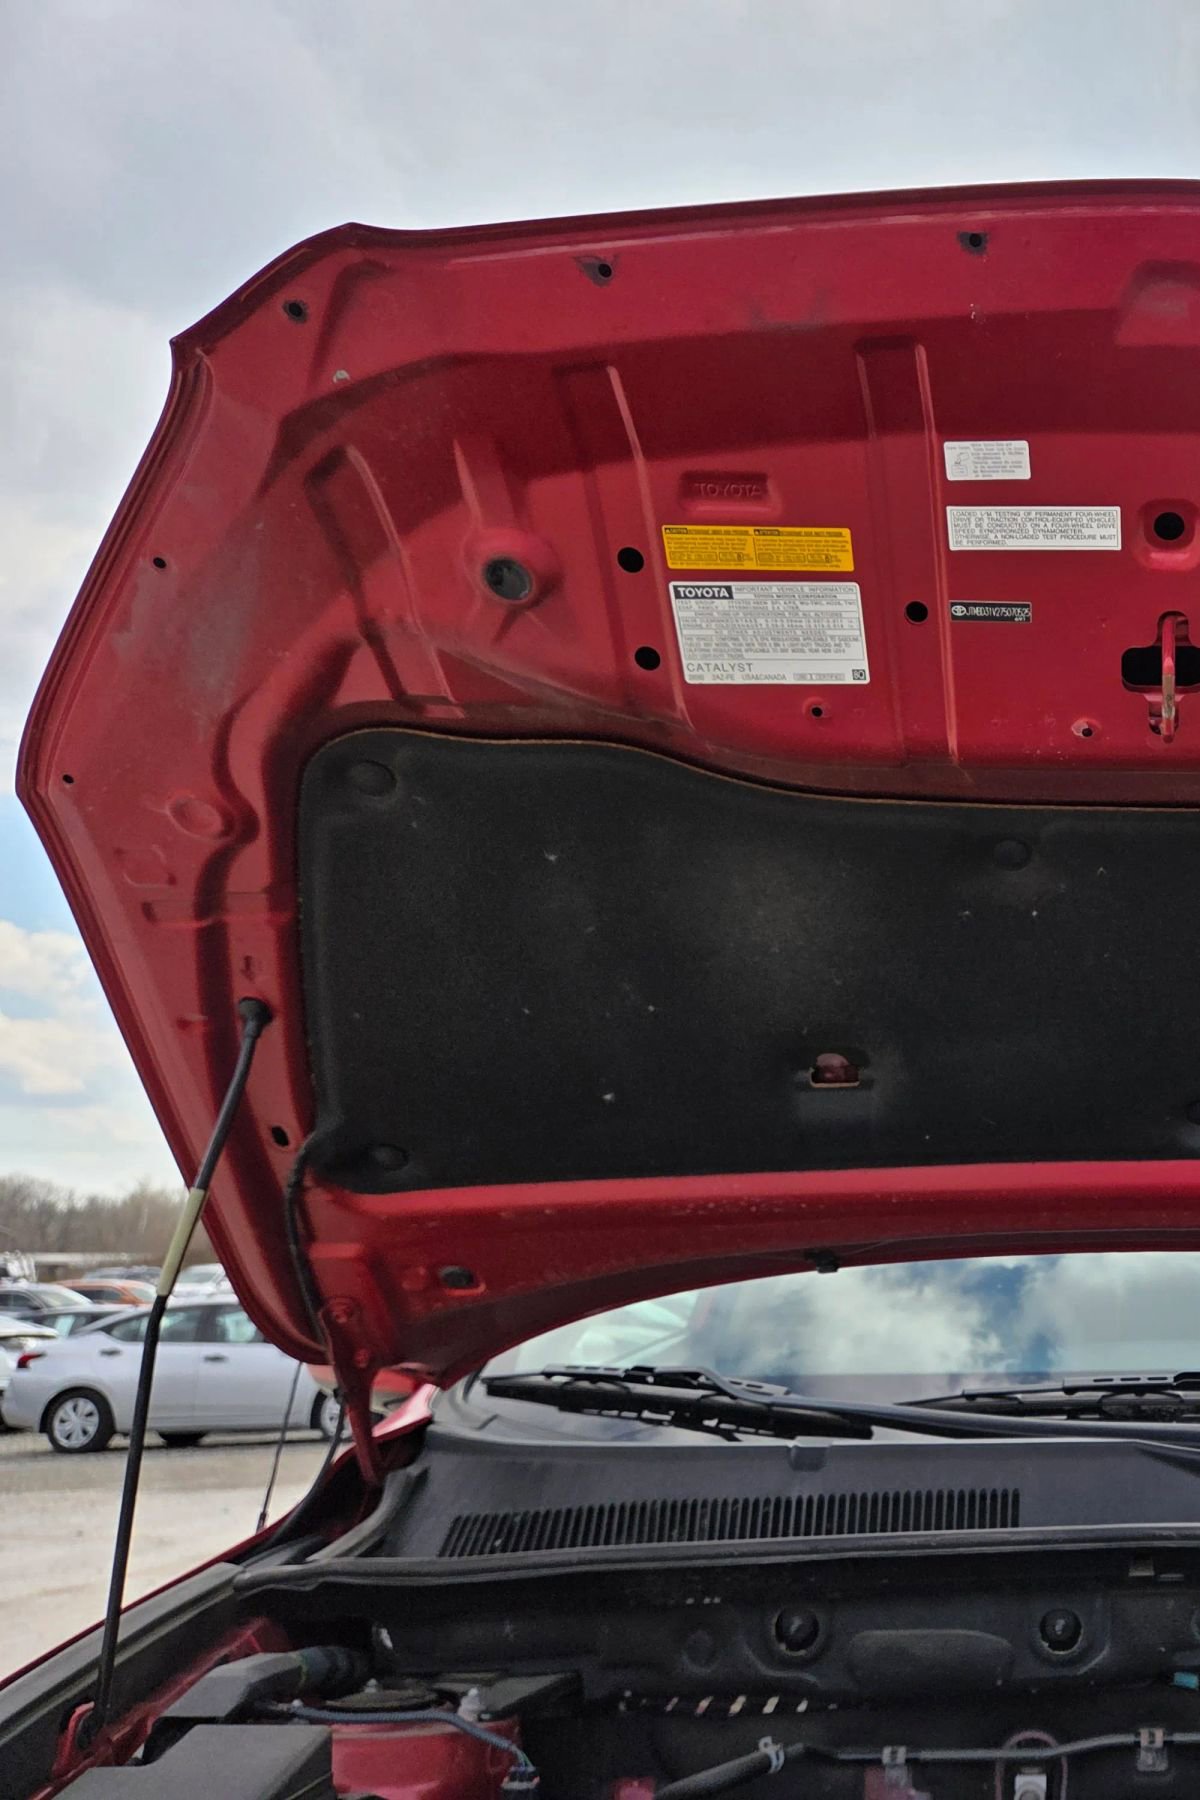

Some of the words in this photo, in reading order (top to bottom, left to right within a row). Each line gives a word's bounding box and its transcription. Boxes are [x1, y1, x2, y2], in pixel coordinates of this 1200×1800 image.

[694, 483, 761, 497] TOYOTA
[677, 587, 729, 598] TOYOTA
[687, 663, 753, 672] CATALYST
